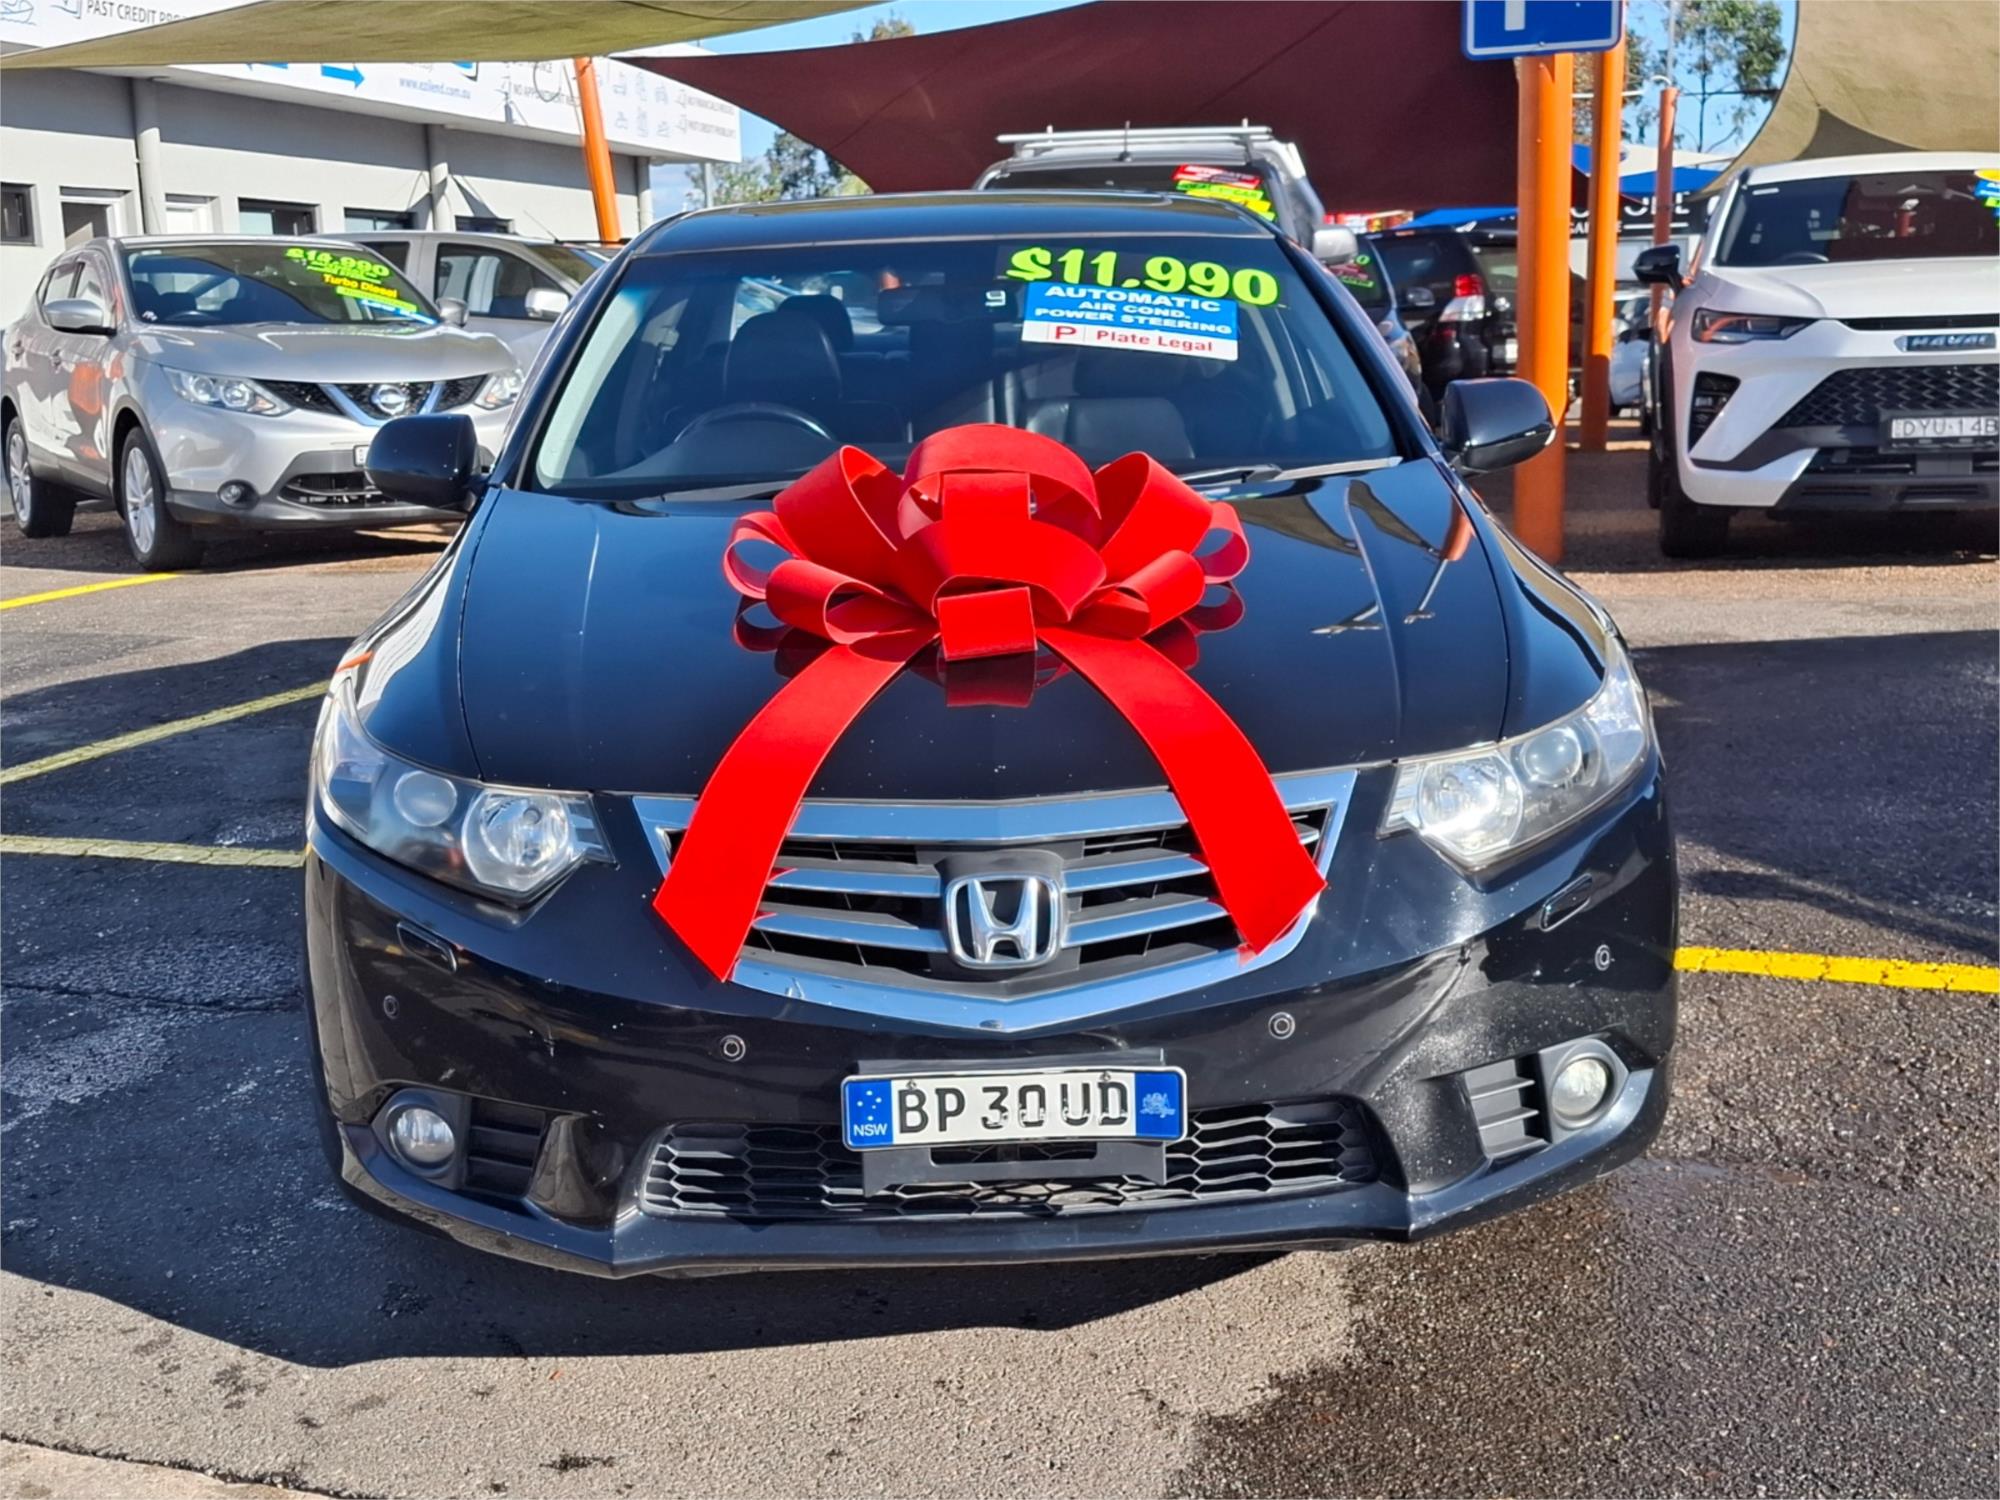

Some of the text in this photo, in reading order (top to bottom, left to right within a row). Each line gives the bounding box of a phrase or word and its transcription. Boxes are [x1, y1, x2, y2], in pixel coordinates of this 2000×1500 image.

[87, 0, 114, 17] PAST
[117, 4, 156, 24] CREDIT
[323, 274, 359, 289] Turbo
[360, 281, 398, 299] Diesel
[1045, 286, 1221, 312] AUTOMATIC
[1034, 308, 1233, 334] POWER STEERING
[1079, 301, 1191, 319] AIR COND.
[1055, 325, 1212, 352] P Plate Legal
[898, 1081, 1129, 1134] BP 30 UD
[853, 1123, 888, 1136] NSW
